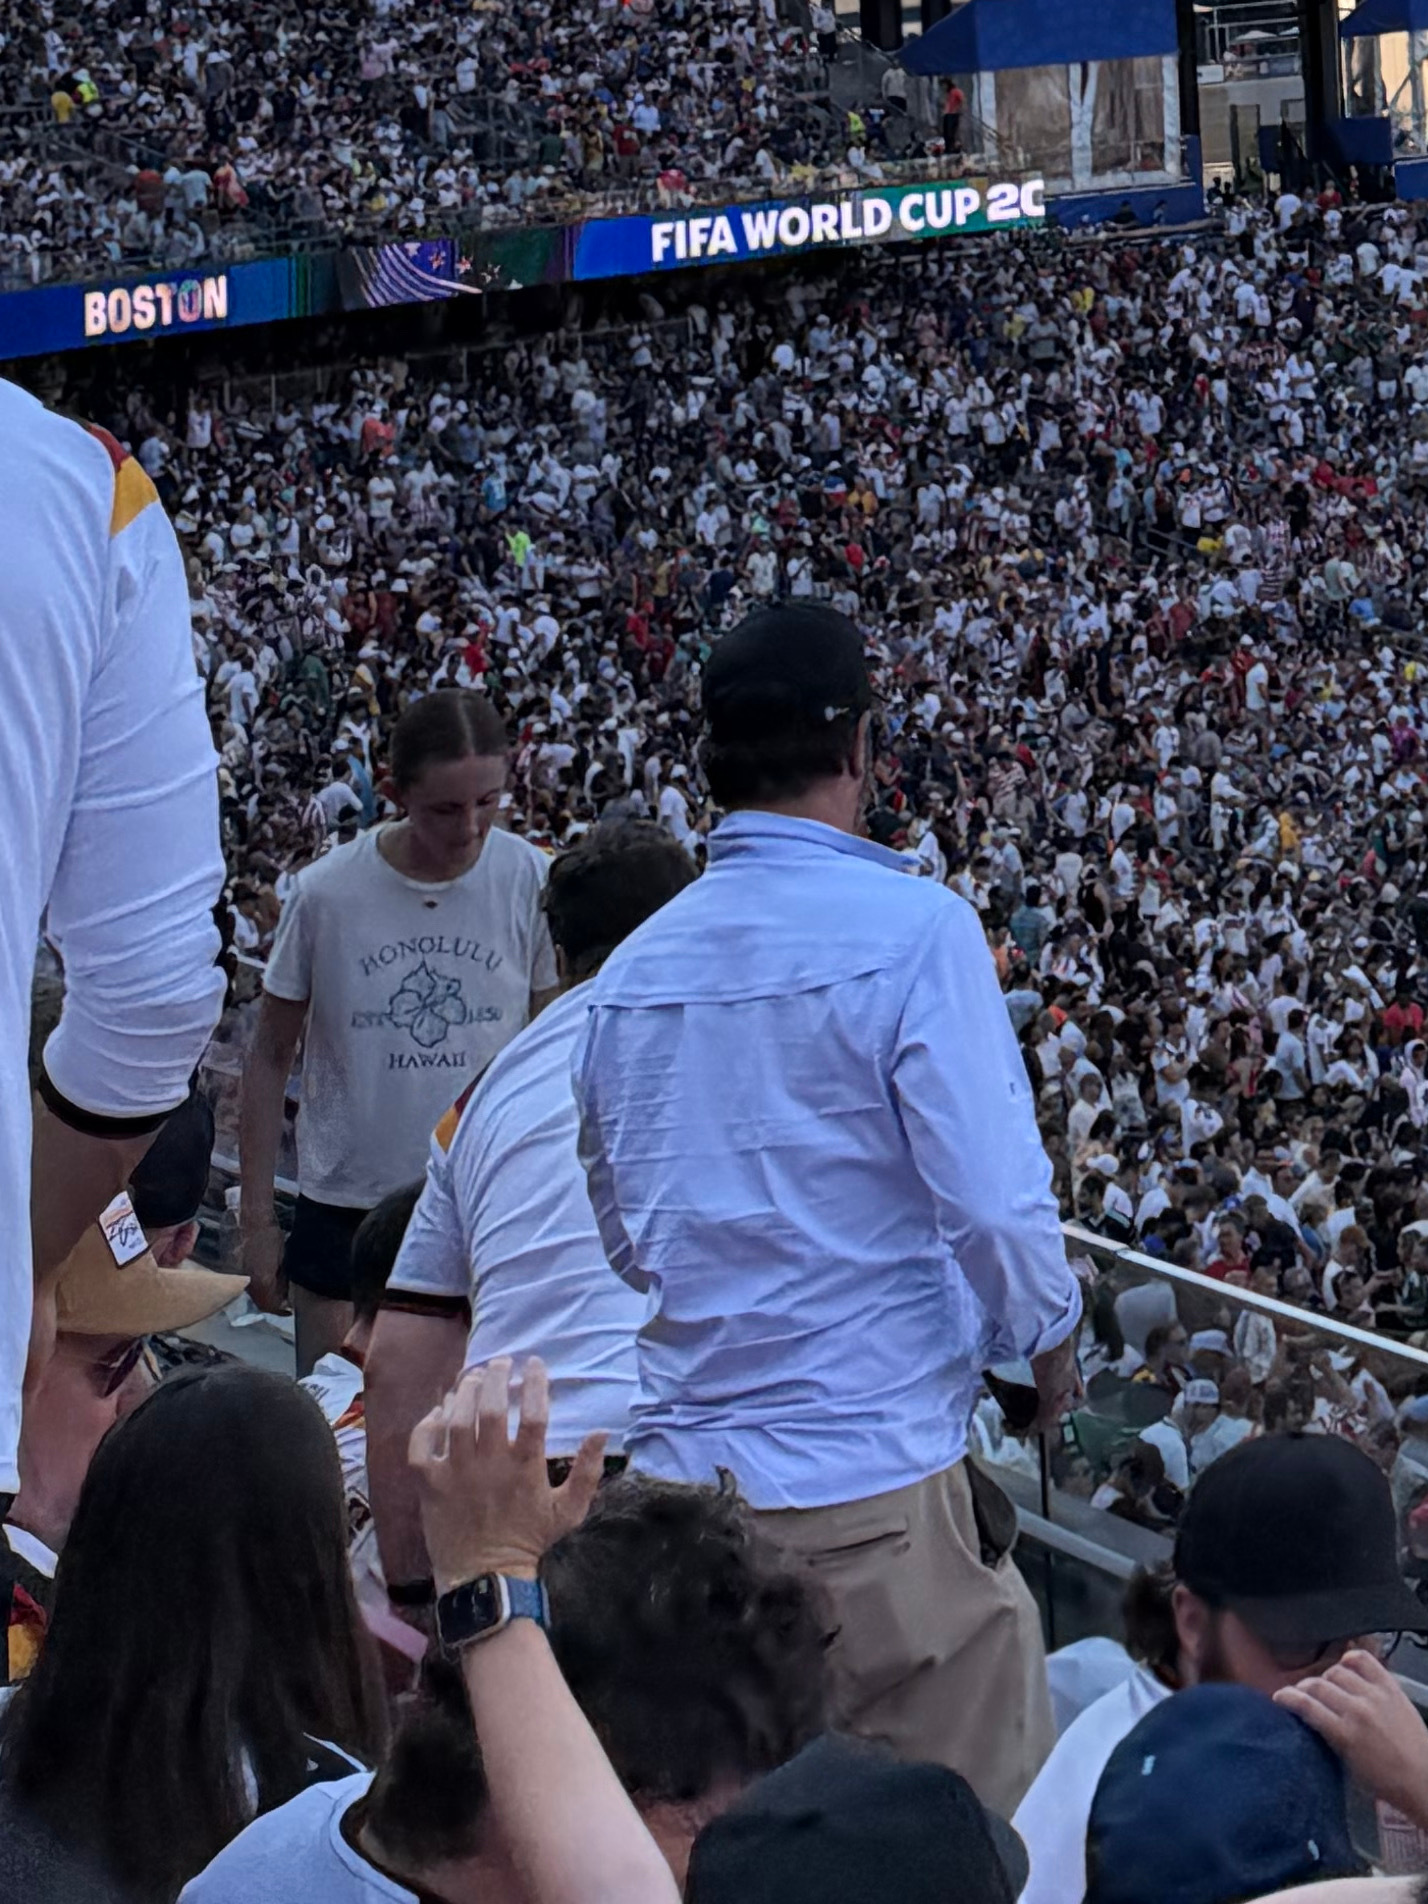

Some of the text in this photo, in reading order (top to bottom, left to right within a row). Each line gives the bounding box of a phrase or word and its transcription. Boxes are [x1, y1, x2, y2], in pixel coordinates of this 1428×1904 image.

[652, 214, 738, 264] FIFA
[741, 197, 893, 252] WORLD
[898, 188, 981, 231] CUP
[84, 275, 228, 337] BOSTON
[360, 935, 503, 977] HONOLULU
[389, 1051, 467, 1070] HAWAII
